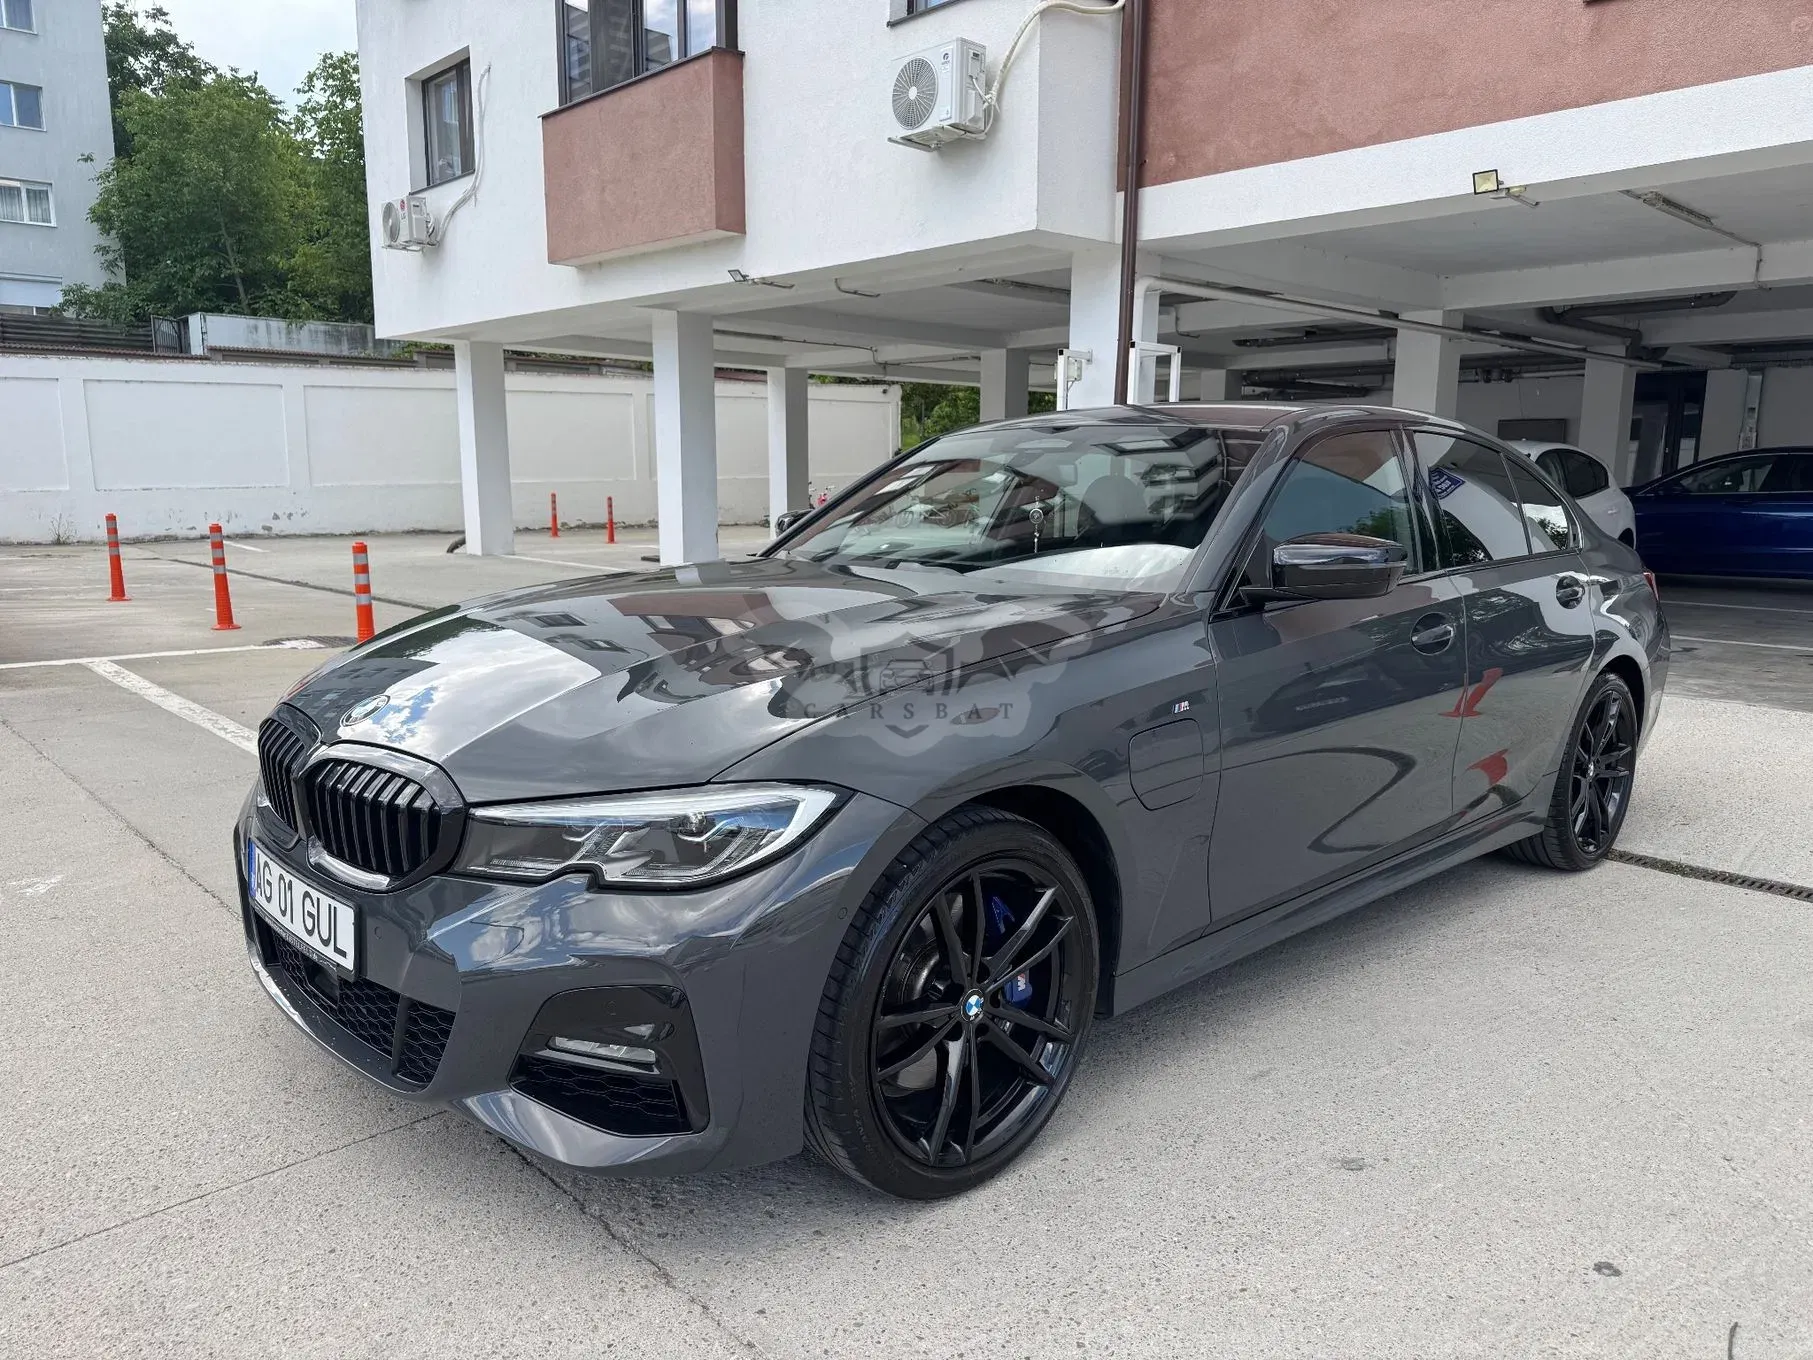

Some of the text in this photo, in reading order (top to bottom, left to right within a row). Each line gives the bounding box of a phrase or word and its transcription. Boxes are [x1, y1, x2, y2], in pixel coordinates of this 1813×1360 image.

[256, 853, 273, 904] AG
[278, 872, 294, 925] 01
[302, 890, 347, 959] GUL
